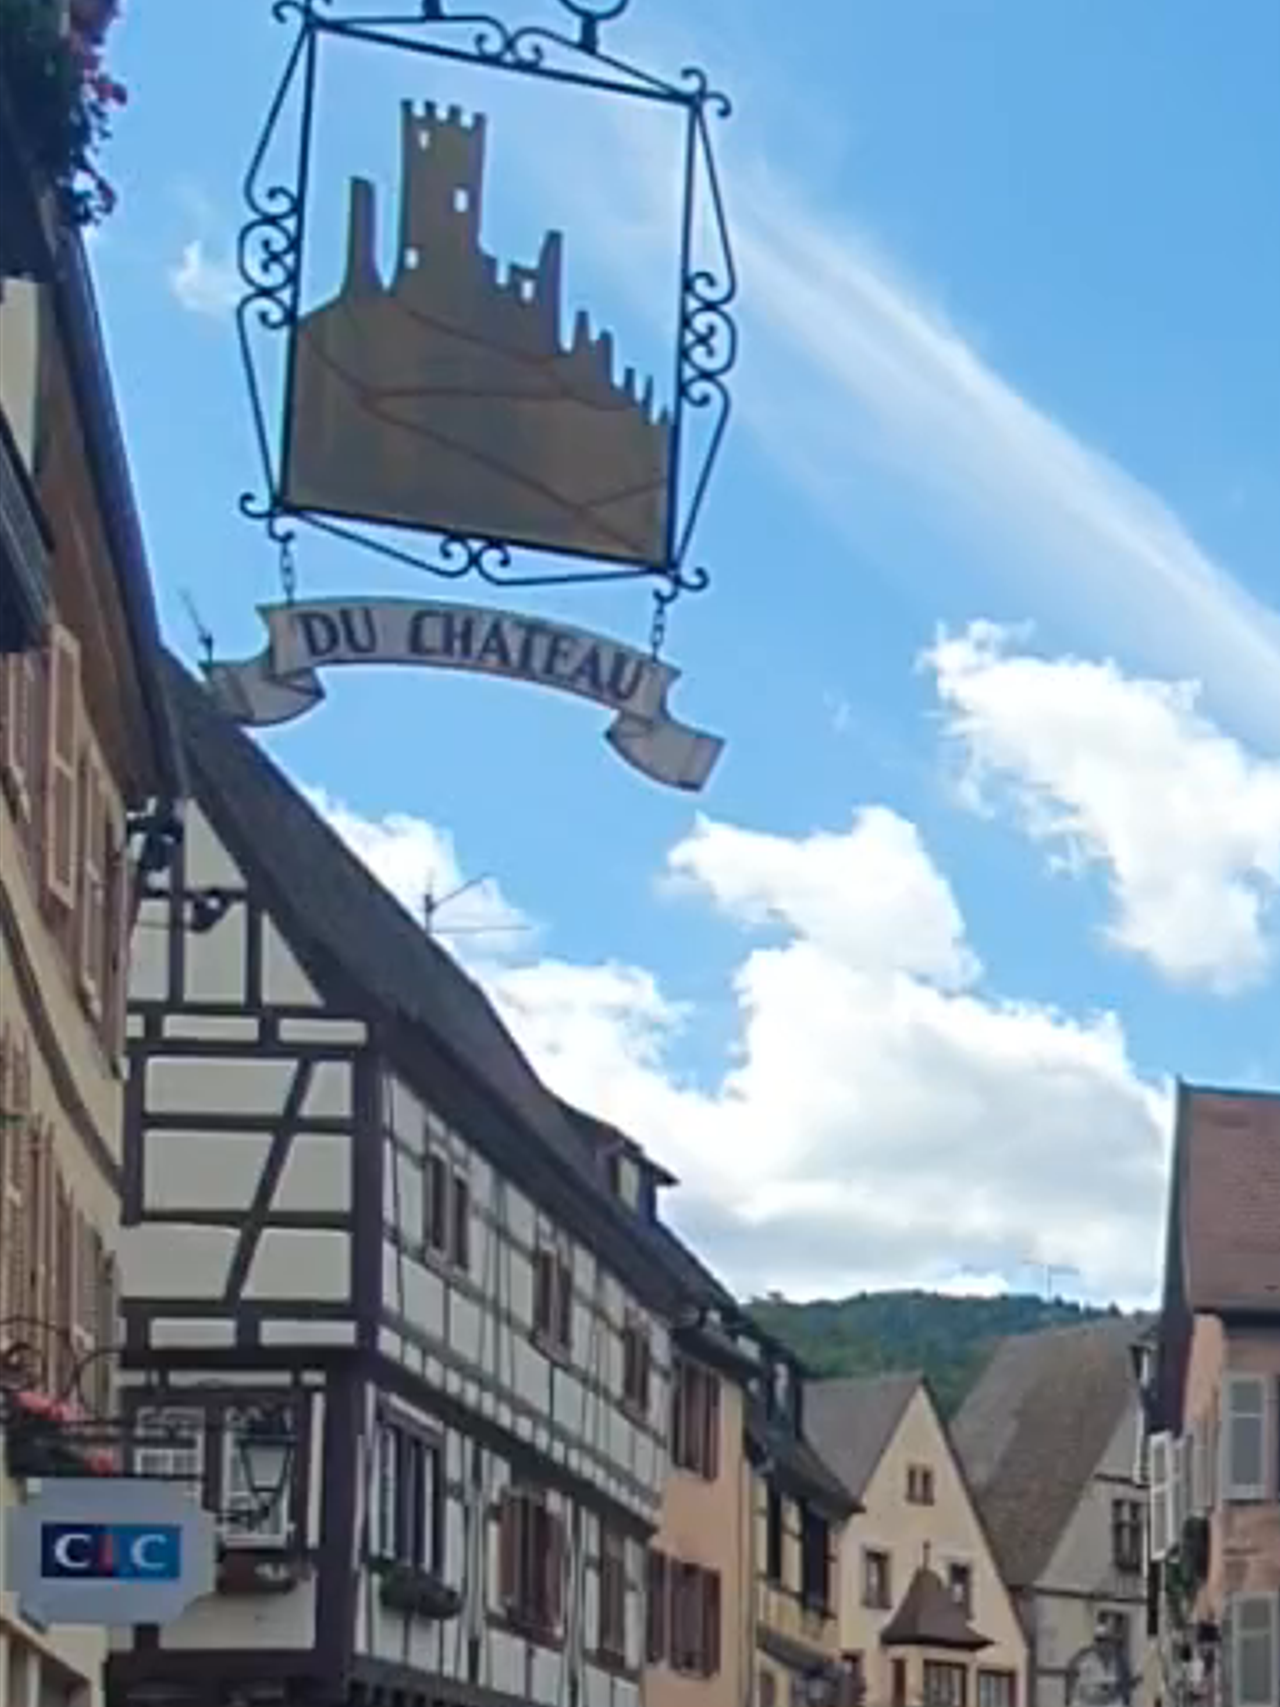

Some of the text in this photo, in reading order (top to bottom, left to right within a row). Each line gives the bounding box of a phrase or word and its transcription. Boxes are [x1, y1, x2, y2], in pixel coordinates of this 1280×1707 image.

[298, 607, 644, 700] DU CHATEAU
[54, 1533, 168, 1569] CIC
